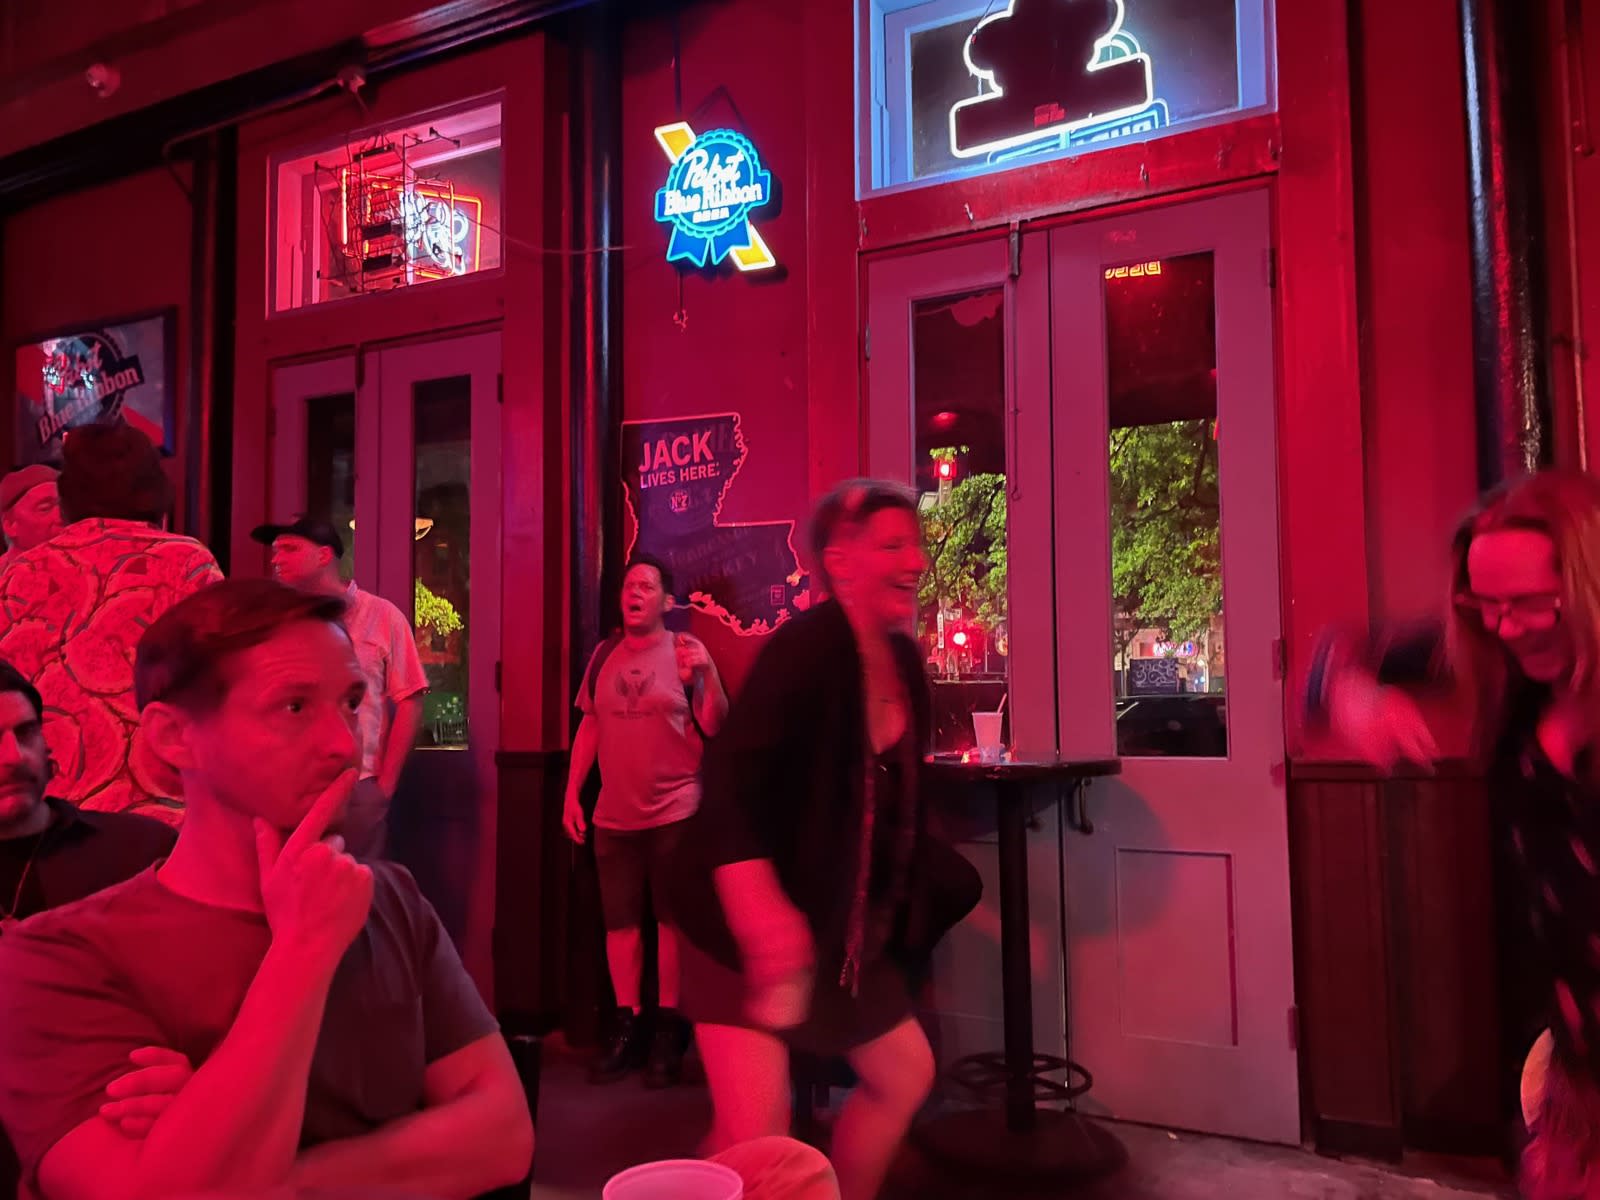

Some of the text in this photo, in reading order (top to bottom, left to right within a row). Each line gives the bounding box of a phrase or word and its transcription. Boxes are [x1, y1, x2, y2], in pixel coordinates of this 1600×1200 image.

[682, 148, 744, 190] Pabst
[664, 180, 763, 216] Blue Ribbon
[37, 402, 75, 444] Blue
[638, 430, 714, 473] JACK
[640, 470, 676, 489] LIVES
